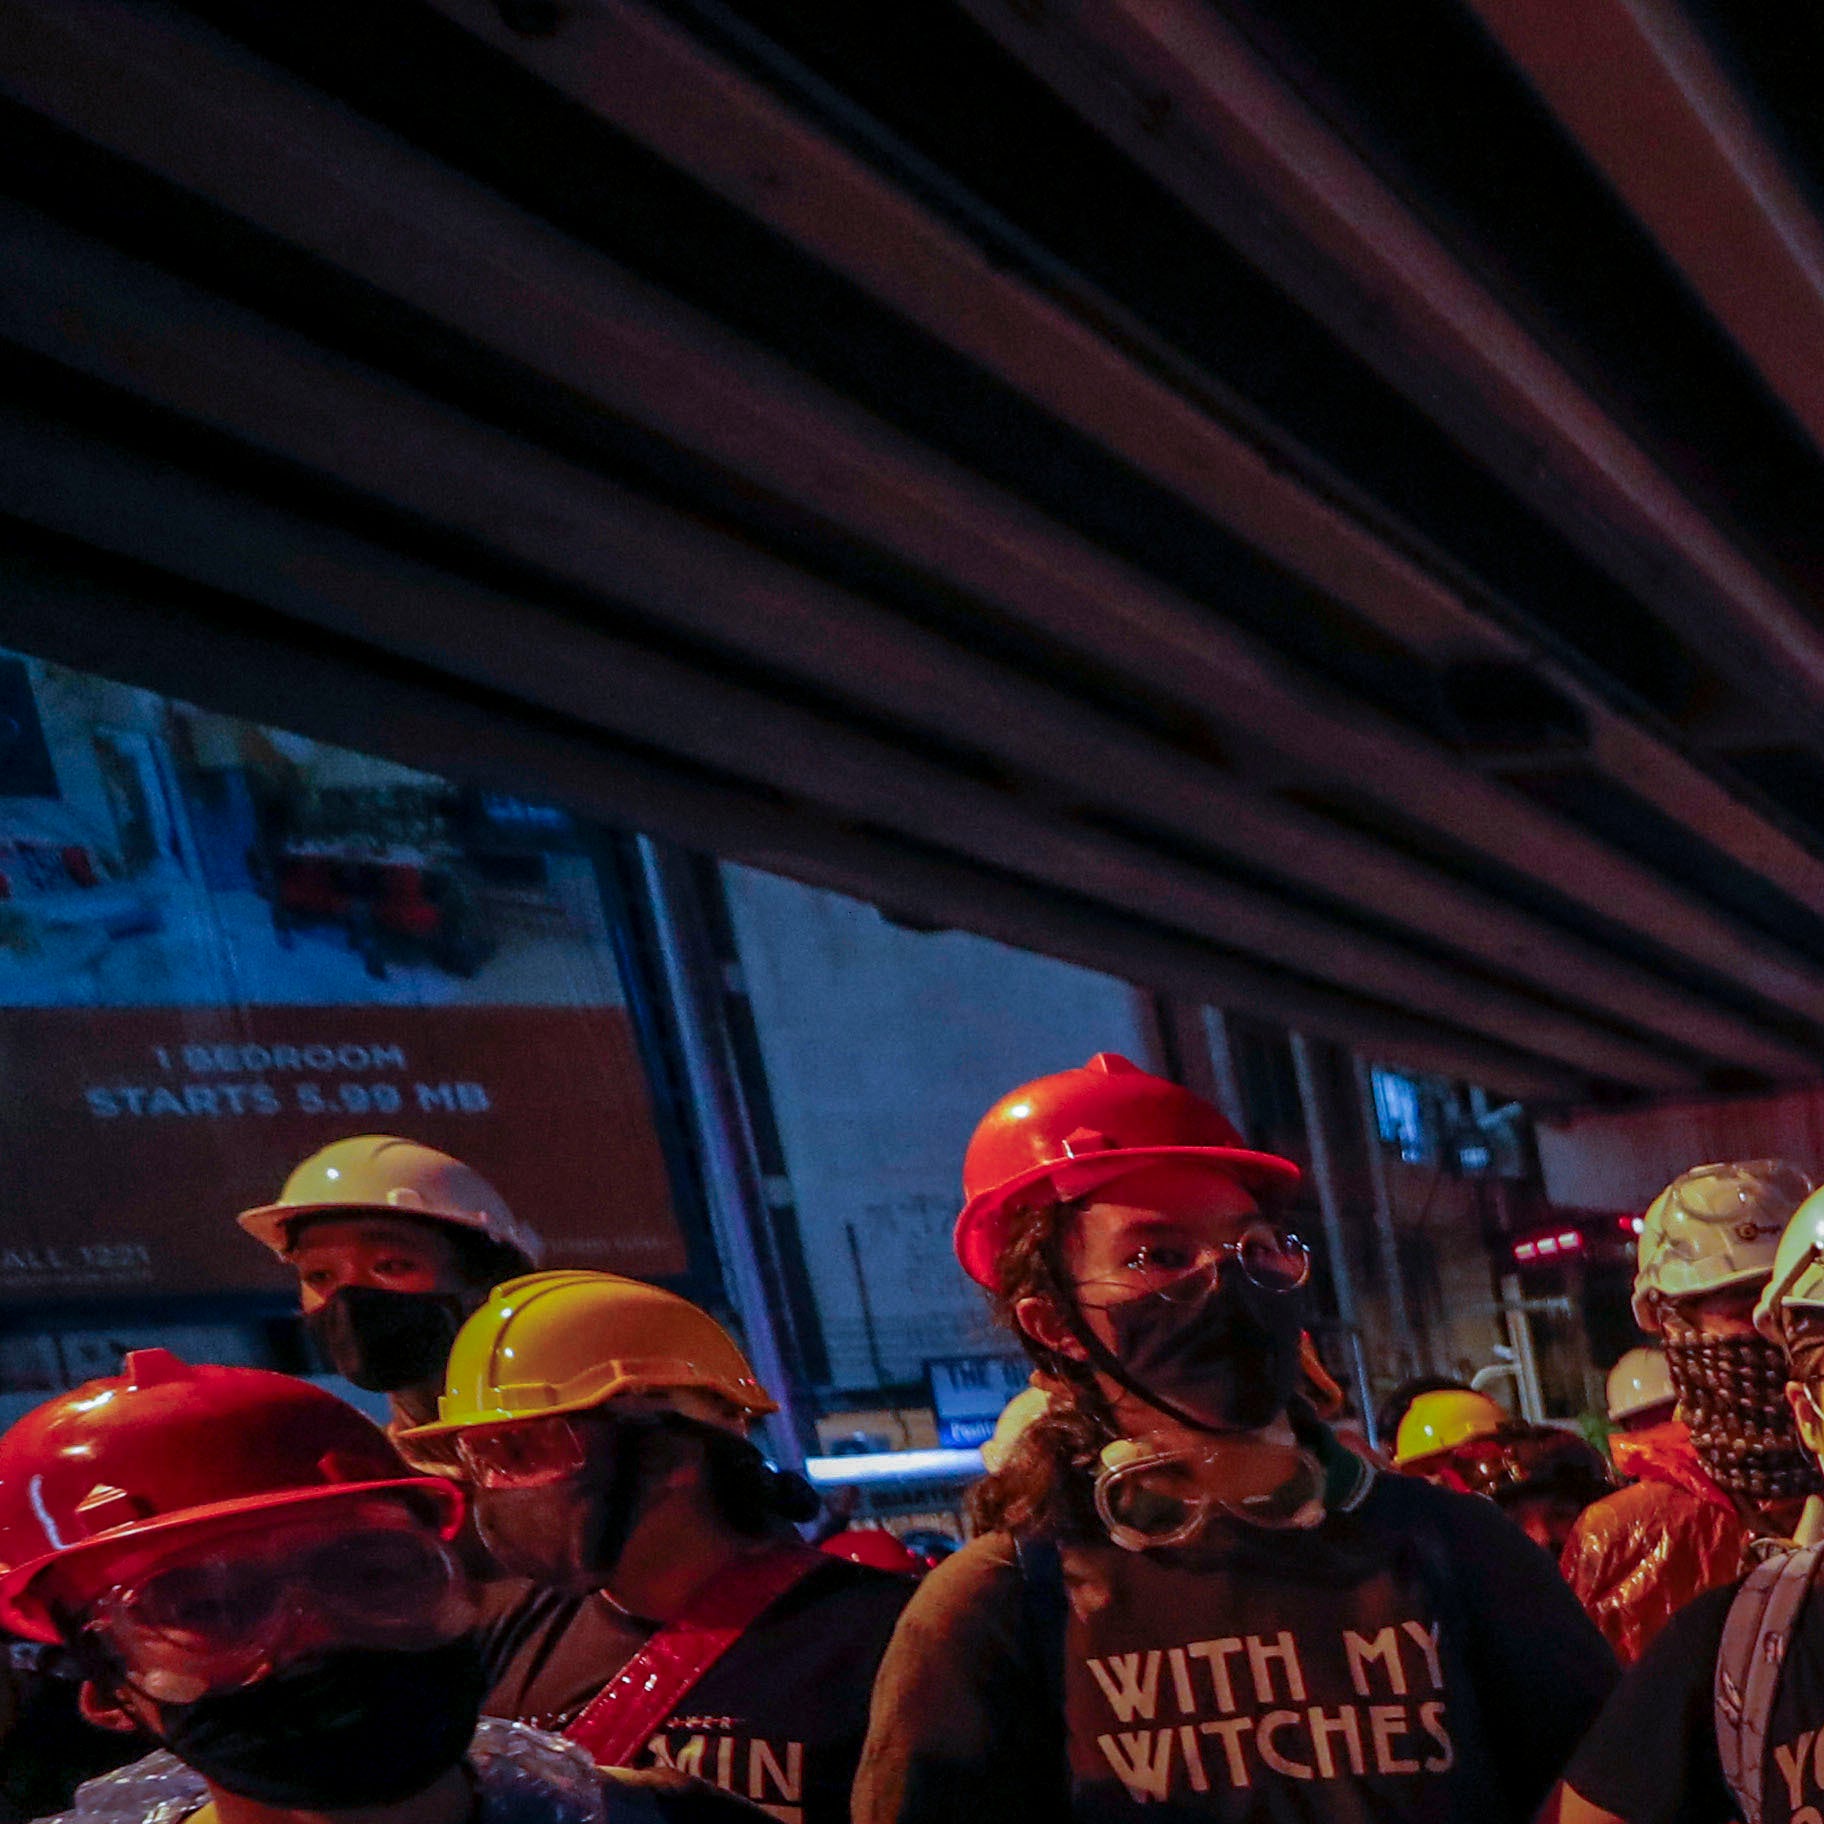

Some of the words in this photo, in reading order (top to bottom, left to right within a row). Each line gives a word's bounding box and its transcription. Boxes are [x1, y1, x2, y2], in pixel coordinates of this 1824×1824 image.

[182, 1042, 408, 1072] BEDROOM
[84, 1082, 282, 1118] STARTS
[414, 1081, 491, 1115] MB
[1086, 1629, 1308, 1723] WITH
[1341, 1619, 1444, 1697] MY
[1097, 1701, 1456, 1804] WITCHES
